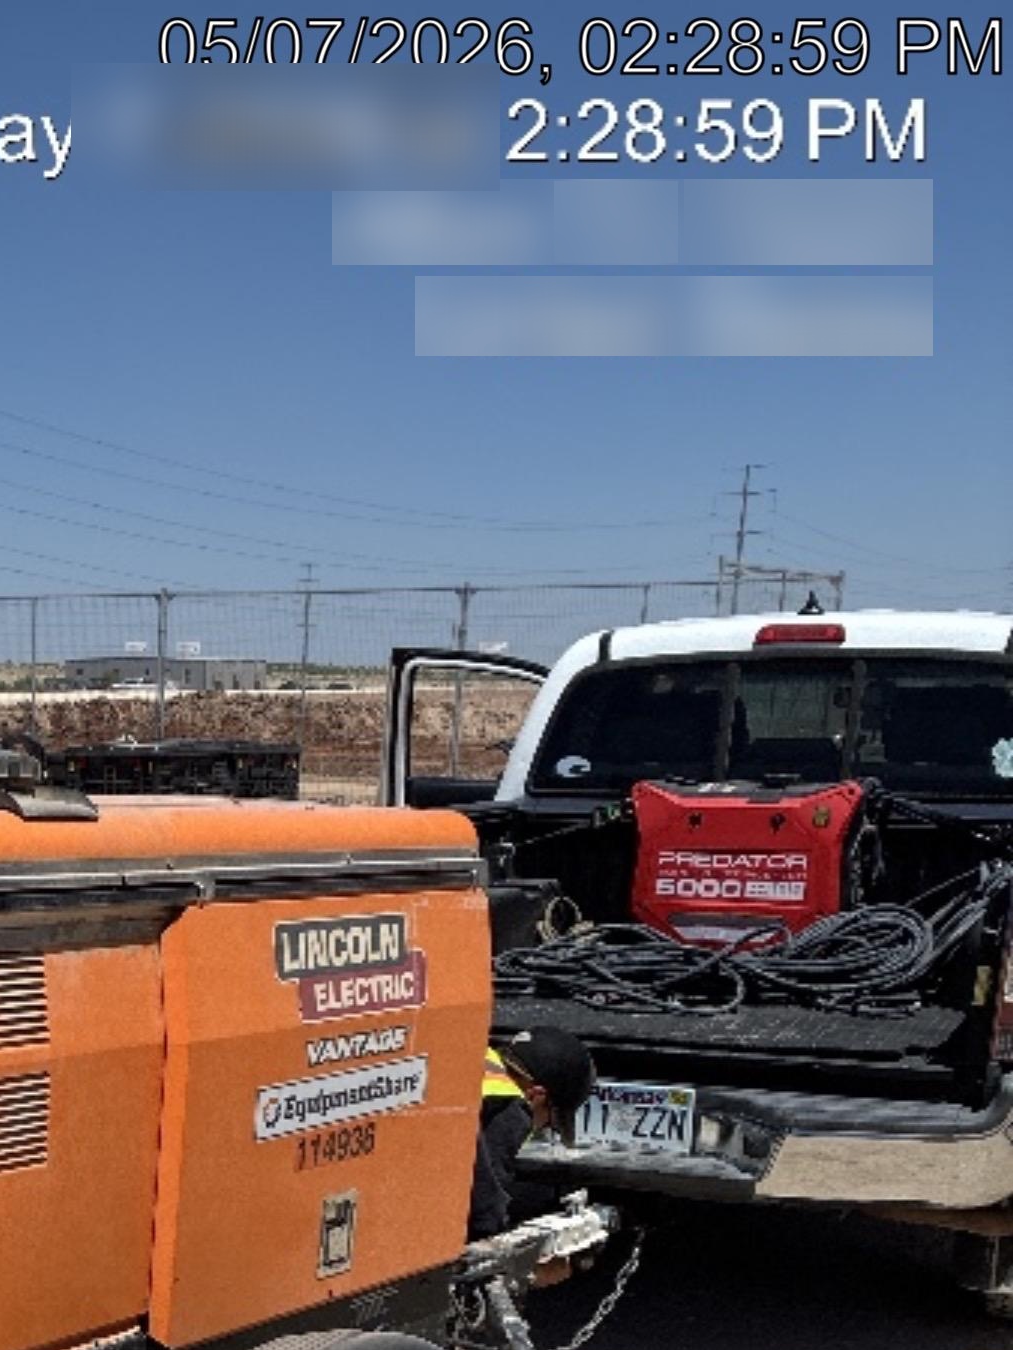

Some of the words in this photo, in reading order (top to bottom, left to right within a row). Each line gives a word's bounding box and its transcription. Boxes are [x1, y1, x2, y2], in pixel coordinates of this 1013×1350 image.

[658, 852, 807, 869] PREDATOR
[282, 923, 400, 973] LINCOLN
[313, 971, 415, 1013] ELECTRIC
[306, 1027, 408, 1068] VANTAGE
[283, 1073, 421, 1123] EquipmentShare
[631, 1106, 687, 1141] ZZN
